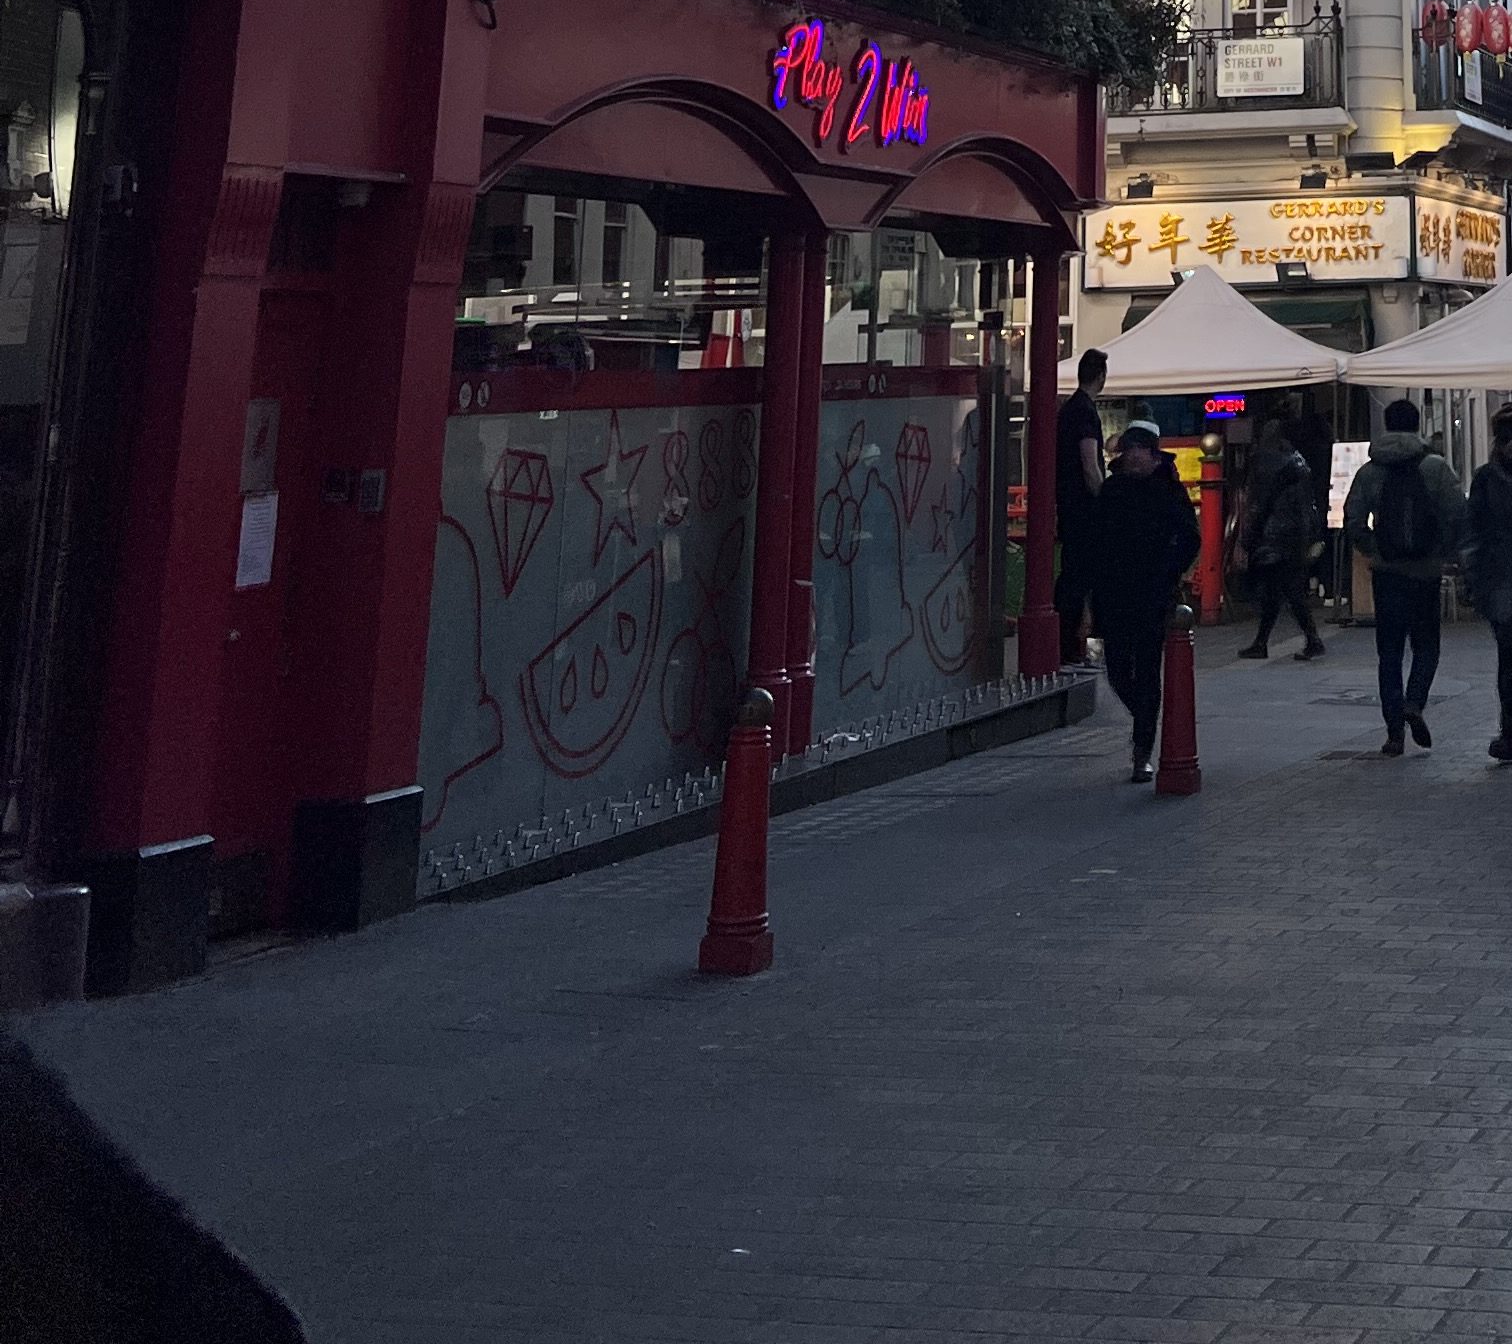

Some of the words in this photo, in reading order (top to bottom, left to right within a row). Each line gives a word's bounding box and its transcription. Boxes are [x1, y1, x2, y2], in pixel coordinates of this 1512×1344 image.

[1224, 43, 1275, 56] GERRARD
[1224, 56, 1264, 69] STREET
[1266, 56, 1283, 68] W1
[773, 17, 843, 140] Play
[847, 39, 881, 144] 2
[881, 59, 930, 149] Win
[1270, 198, 1386, 220] GERRARD'S
[1094, 210, 1240, 265] 好年華
[1289, 223, 1374, 241] CORNER
[1240, 242, 1385, 265] RESTAURANT
[1204, 398, 1246, 413] OPEN
